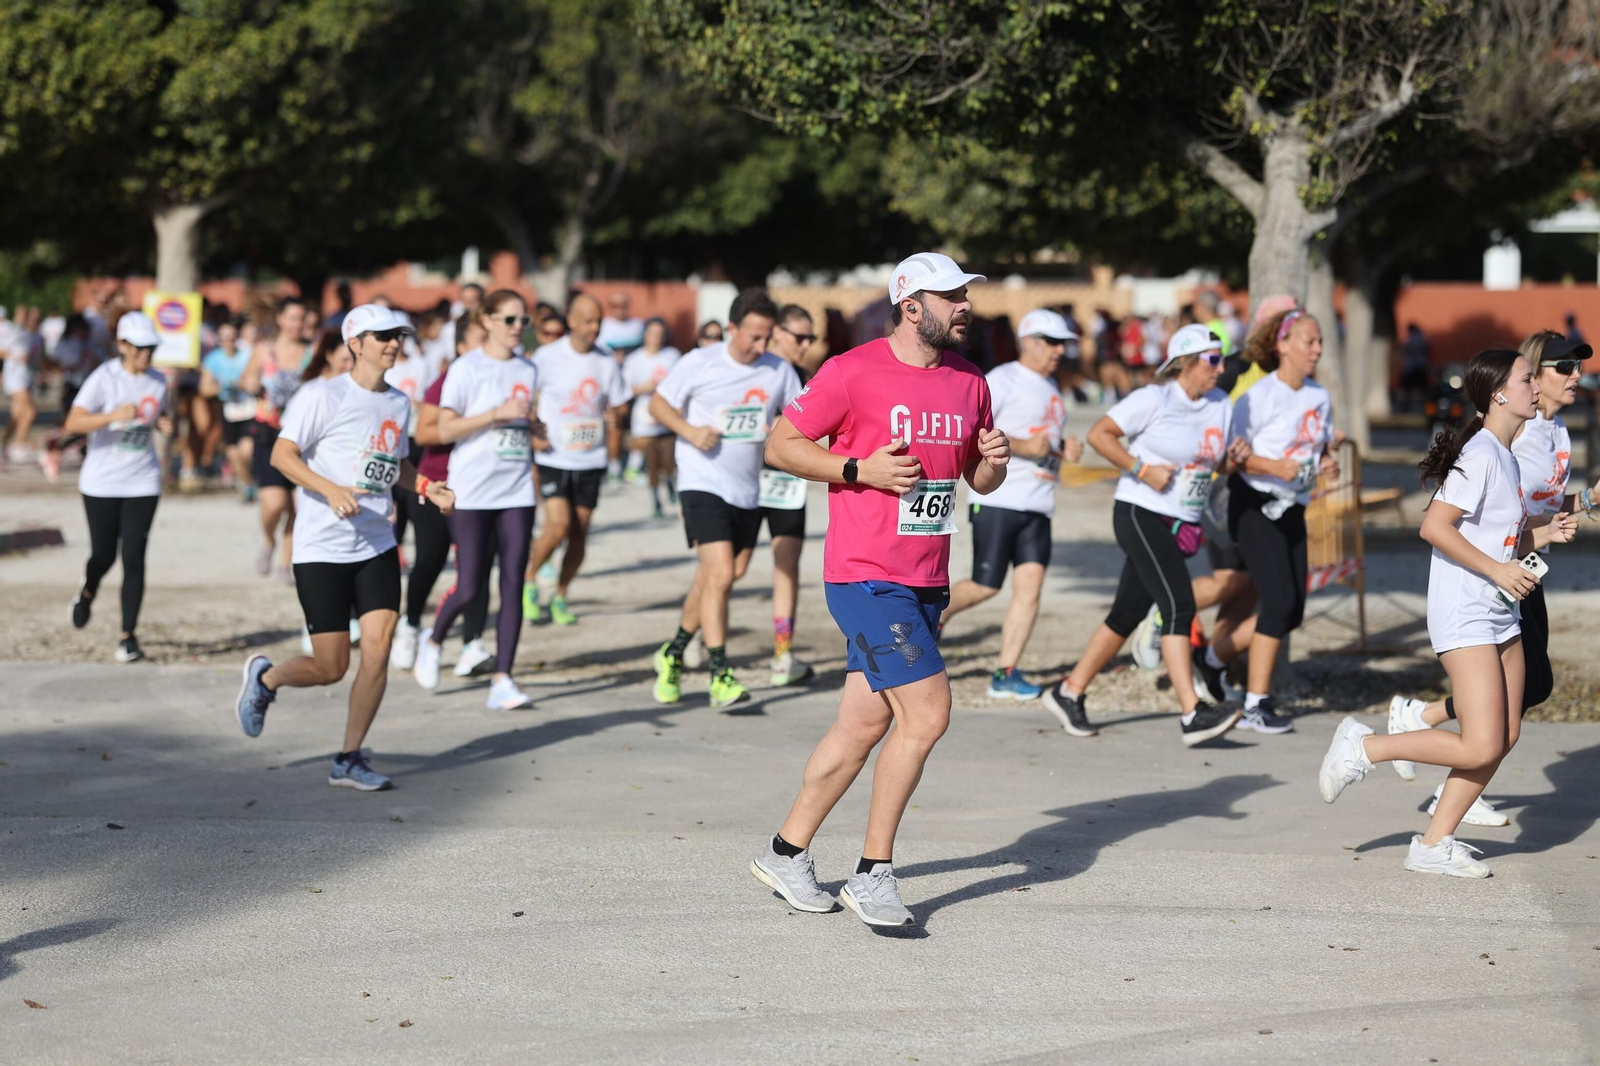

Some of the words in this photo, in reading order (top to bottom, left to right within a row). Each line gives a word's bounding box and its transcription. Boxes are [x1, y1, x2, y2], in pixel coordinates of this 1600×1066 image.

[727, 414, 758, 430] 775
[916, 411, 963, 439] JFIT
[364, 461, 396, 484] 636
[909, 494, 951, 518] 468
